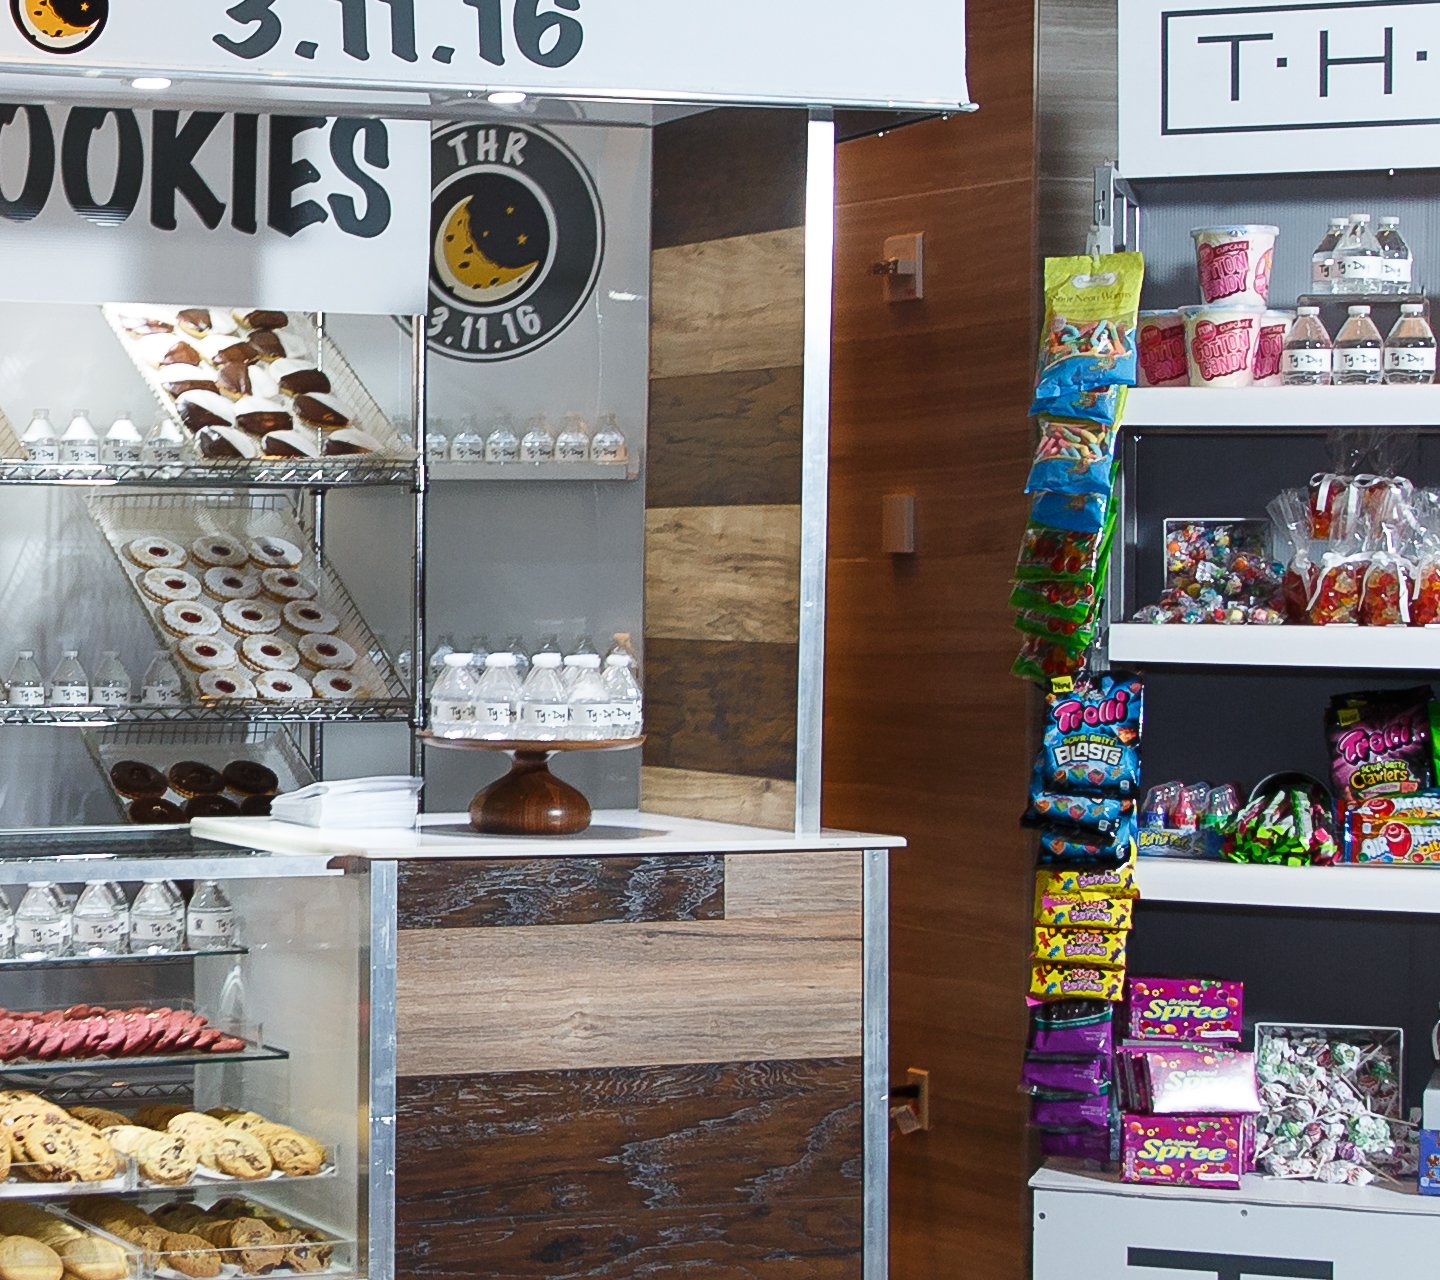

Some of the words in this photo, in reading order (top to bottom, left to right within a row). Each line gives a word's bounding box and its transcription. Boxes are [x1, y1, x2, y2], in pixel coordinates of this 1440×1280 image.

[447, 128, 529, 168] THR
[1050, 291, 1072, 305] Sour
[1074, 291, 1100, 304] Neon
[1101, 289, 1132, 303] Worms
[426, 303, 542, 352] 3.11.16
[1197, 324, 1216, 338] FUN
[1192, 330, 1251, 362] COTTON
[1052, 690, 1126, 733] Trolli
[1063, 734, 1087, 745] SOUR
[1338, 717, 1412, 764] Trolli
[1054, 743, 1122, 766] BLASTS
[1350, 768, 1409, 789] Crawlers
[1363, 835, 1385, 859] AIR
[1144, 999, 1229, 1021] Spree
[1137, 1139, 1228, 1166] Spree
